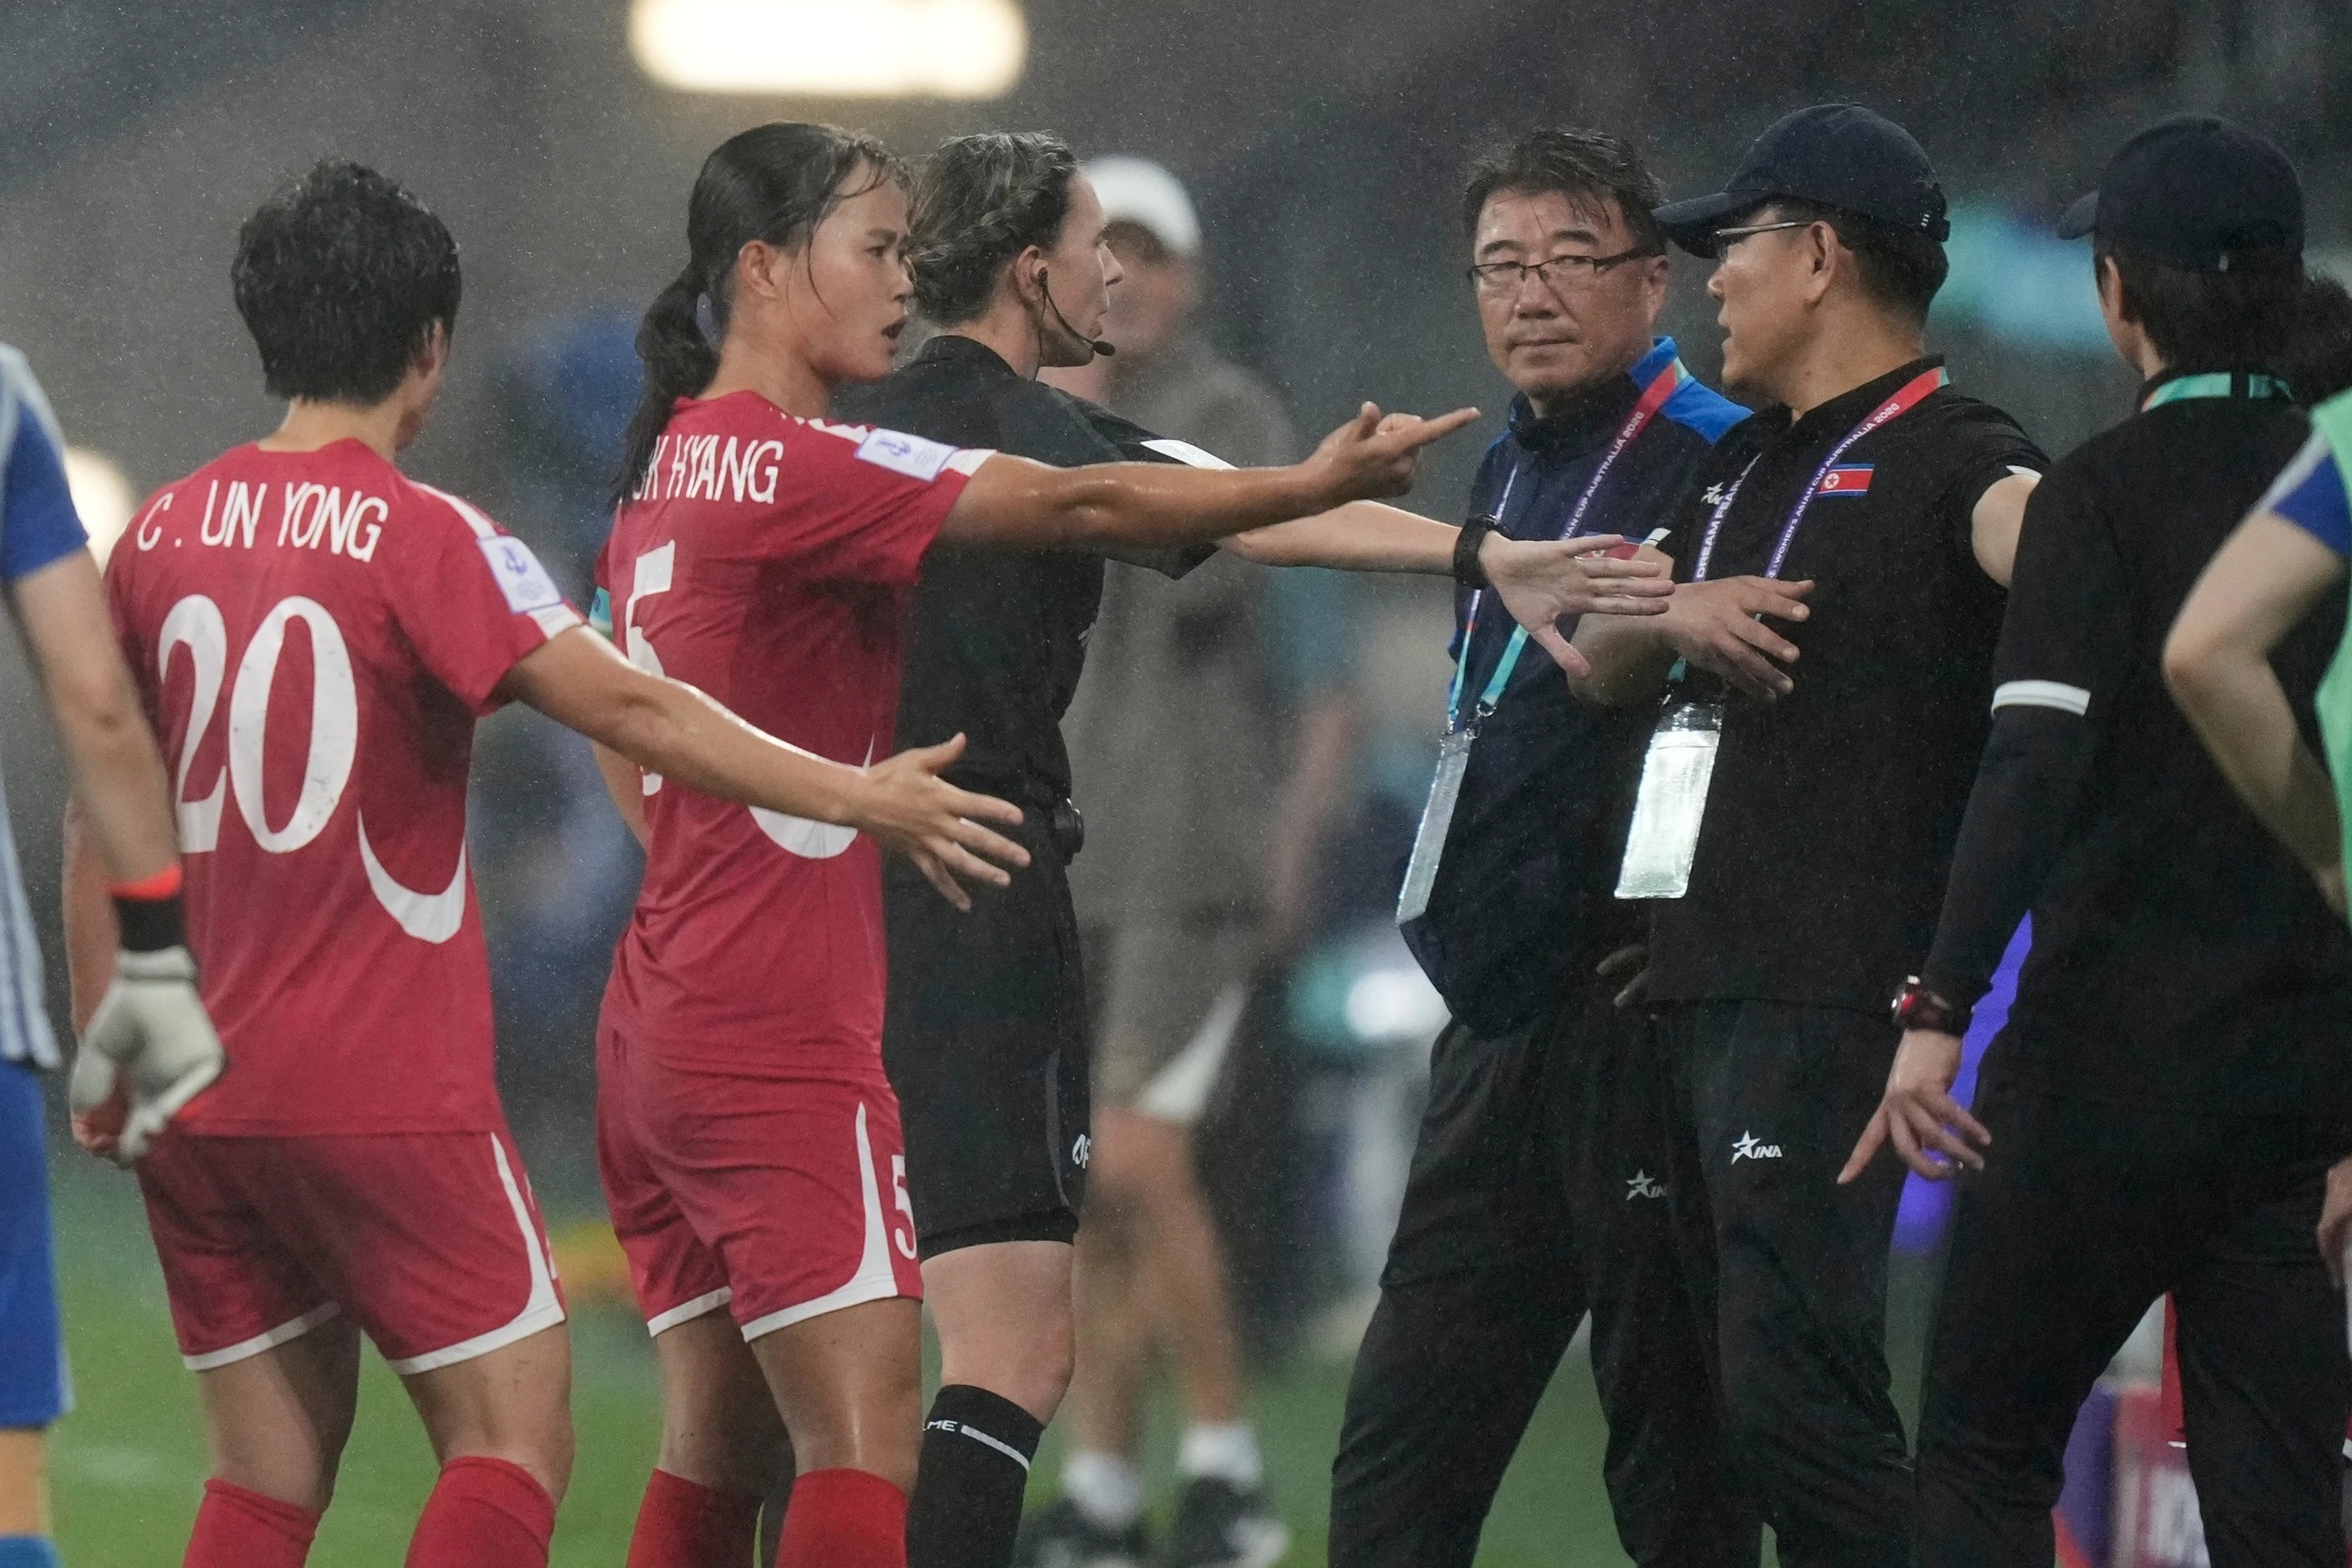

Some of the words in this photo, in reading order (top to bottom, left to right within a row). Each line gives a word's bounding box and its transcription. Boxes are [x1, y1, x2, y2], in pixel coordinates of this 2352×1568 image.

[666, 433, 784, 505] HYANG
[1575, 497, 1589, 518] CUP
[1587, 436, 1627, 498] AUSTRALIA
[1773, 517, 1799, 564] WOMEN'S
[1795, 486, 1815, 517] ASIAN
[1811, 466, 1827, 487] CUP
[1825, 421, 1878, 467] AUSTRALIA
[200, 478, 269, 550] UN
[276, 480, 390, 564] YONG
[1695, 520, 1721, 579] DREAM
[624, 538, 676, 797] 5
[157, 593, 359, 855] 20
[891, 1153, 918, 1260] 5
